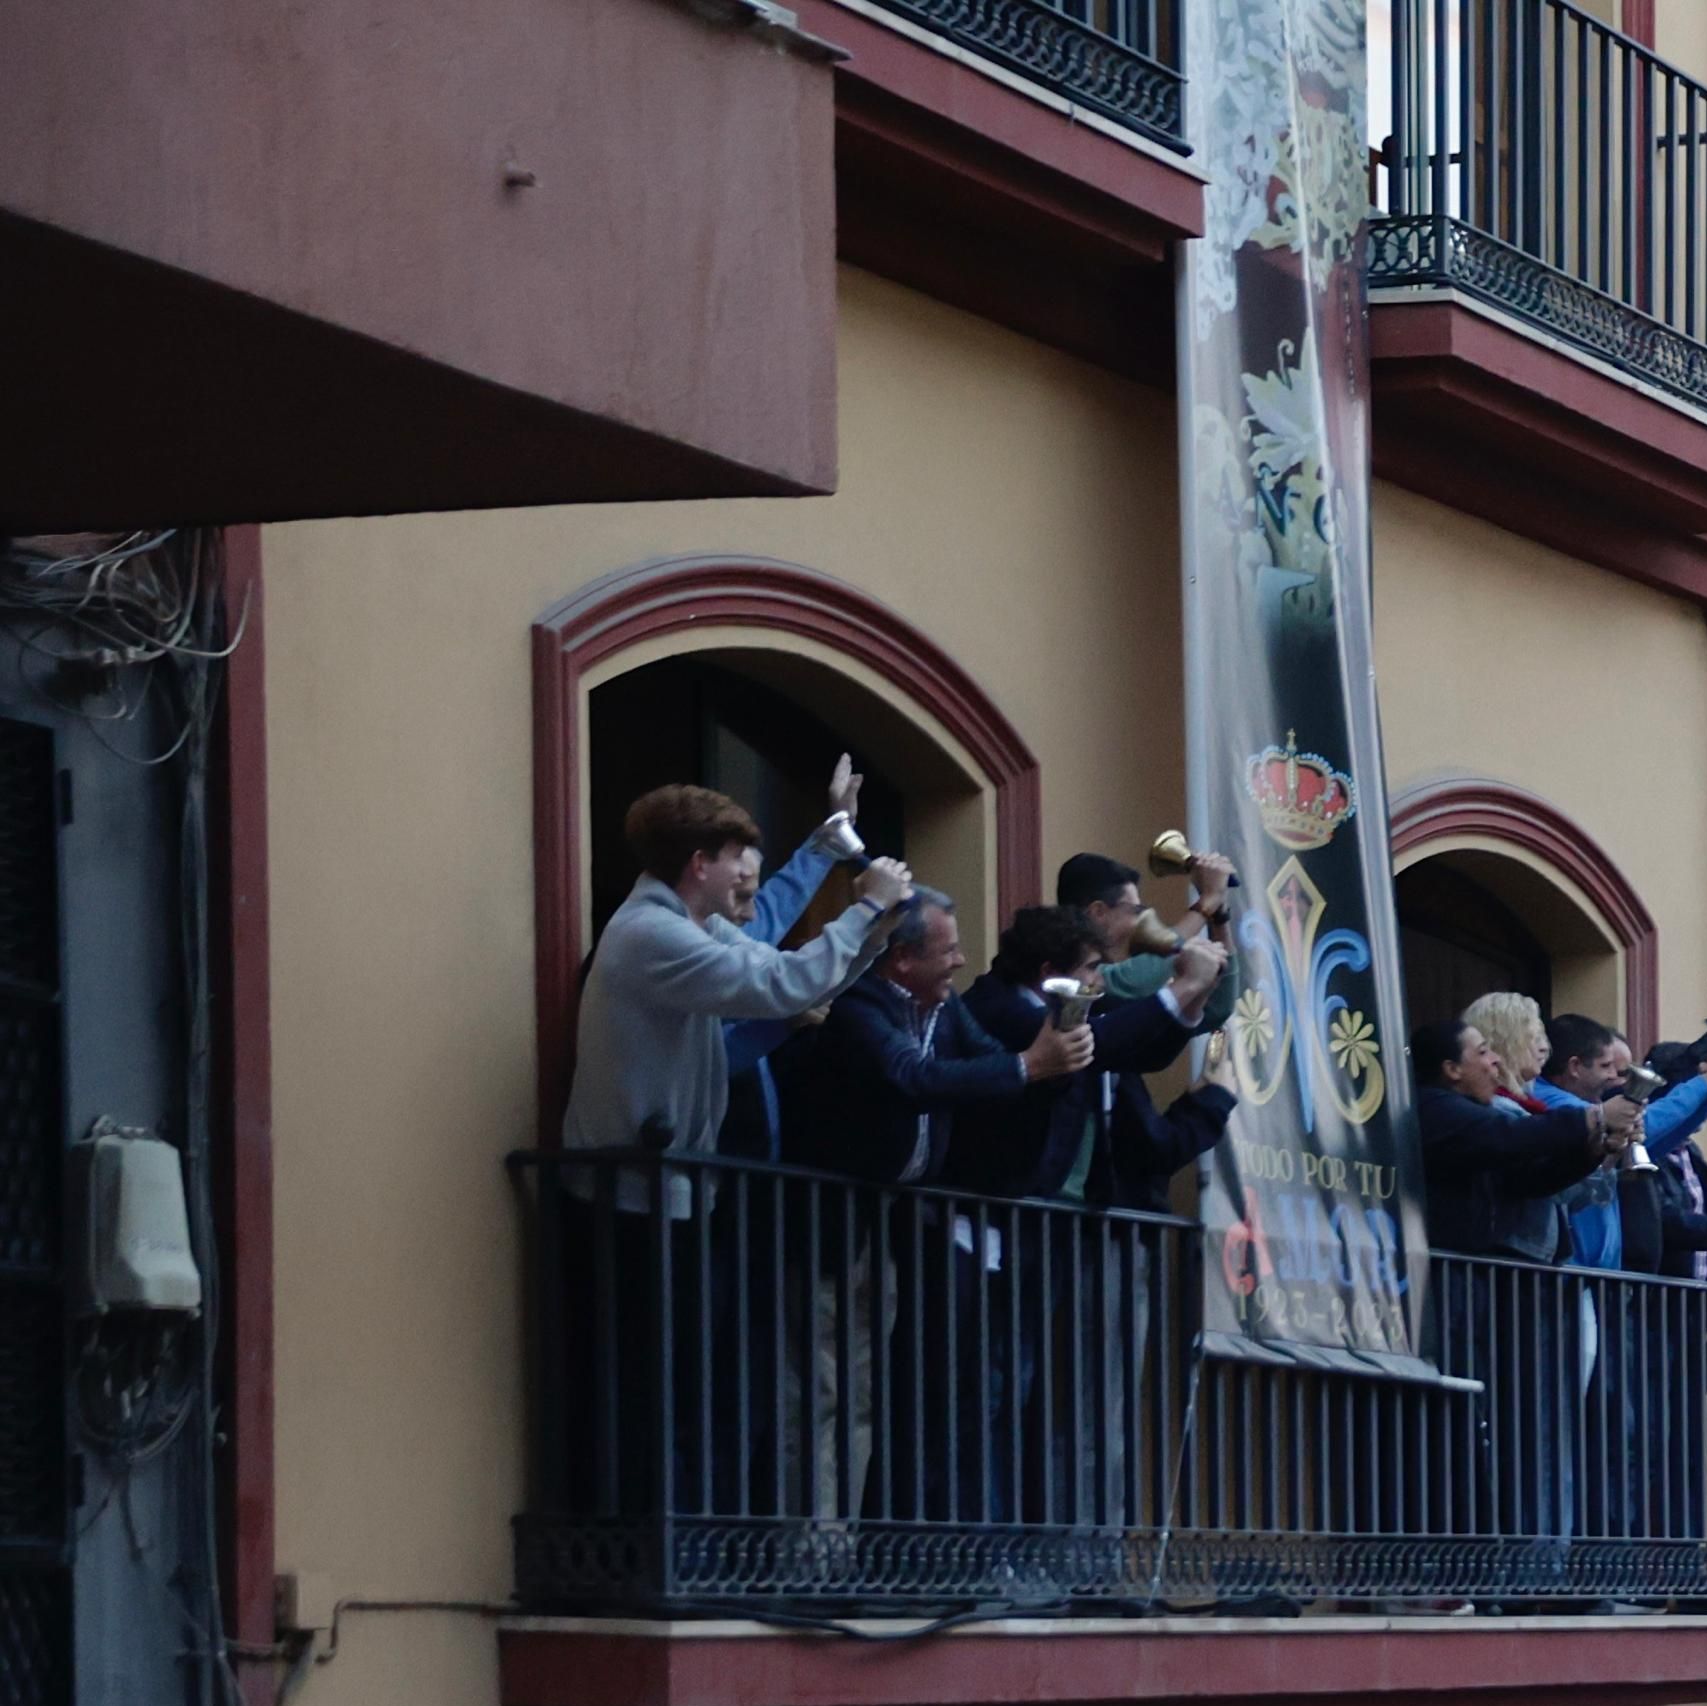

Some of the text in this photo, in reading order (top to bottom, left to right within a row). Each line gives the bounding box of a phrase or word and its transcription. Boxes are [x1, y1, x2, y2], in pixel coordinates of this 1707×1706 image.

[1238, 1140, 1398, 1199] TODO POR TU
